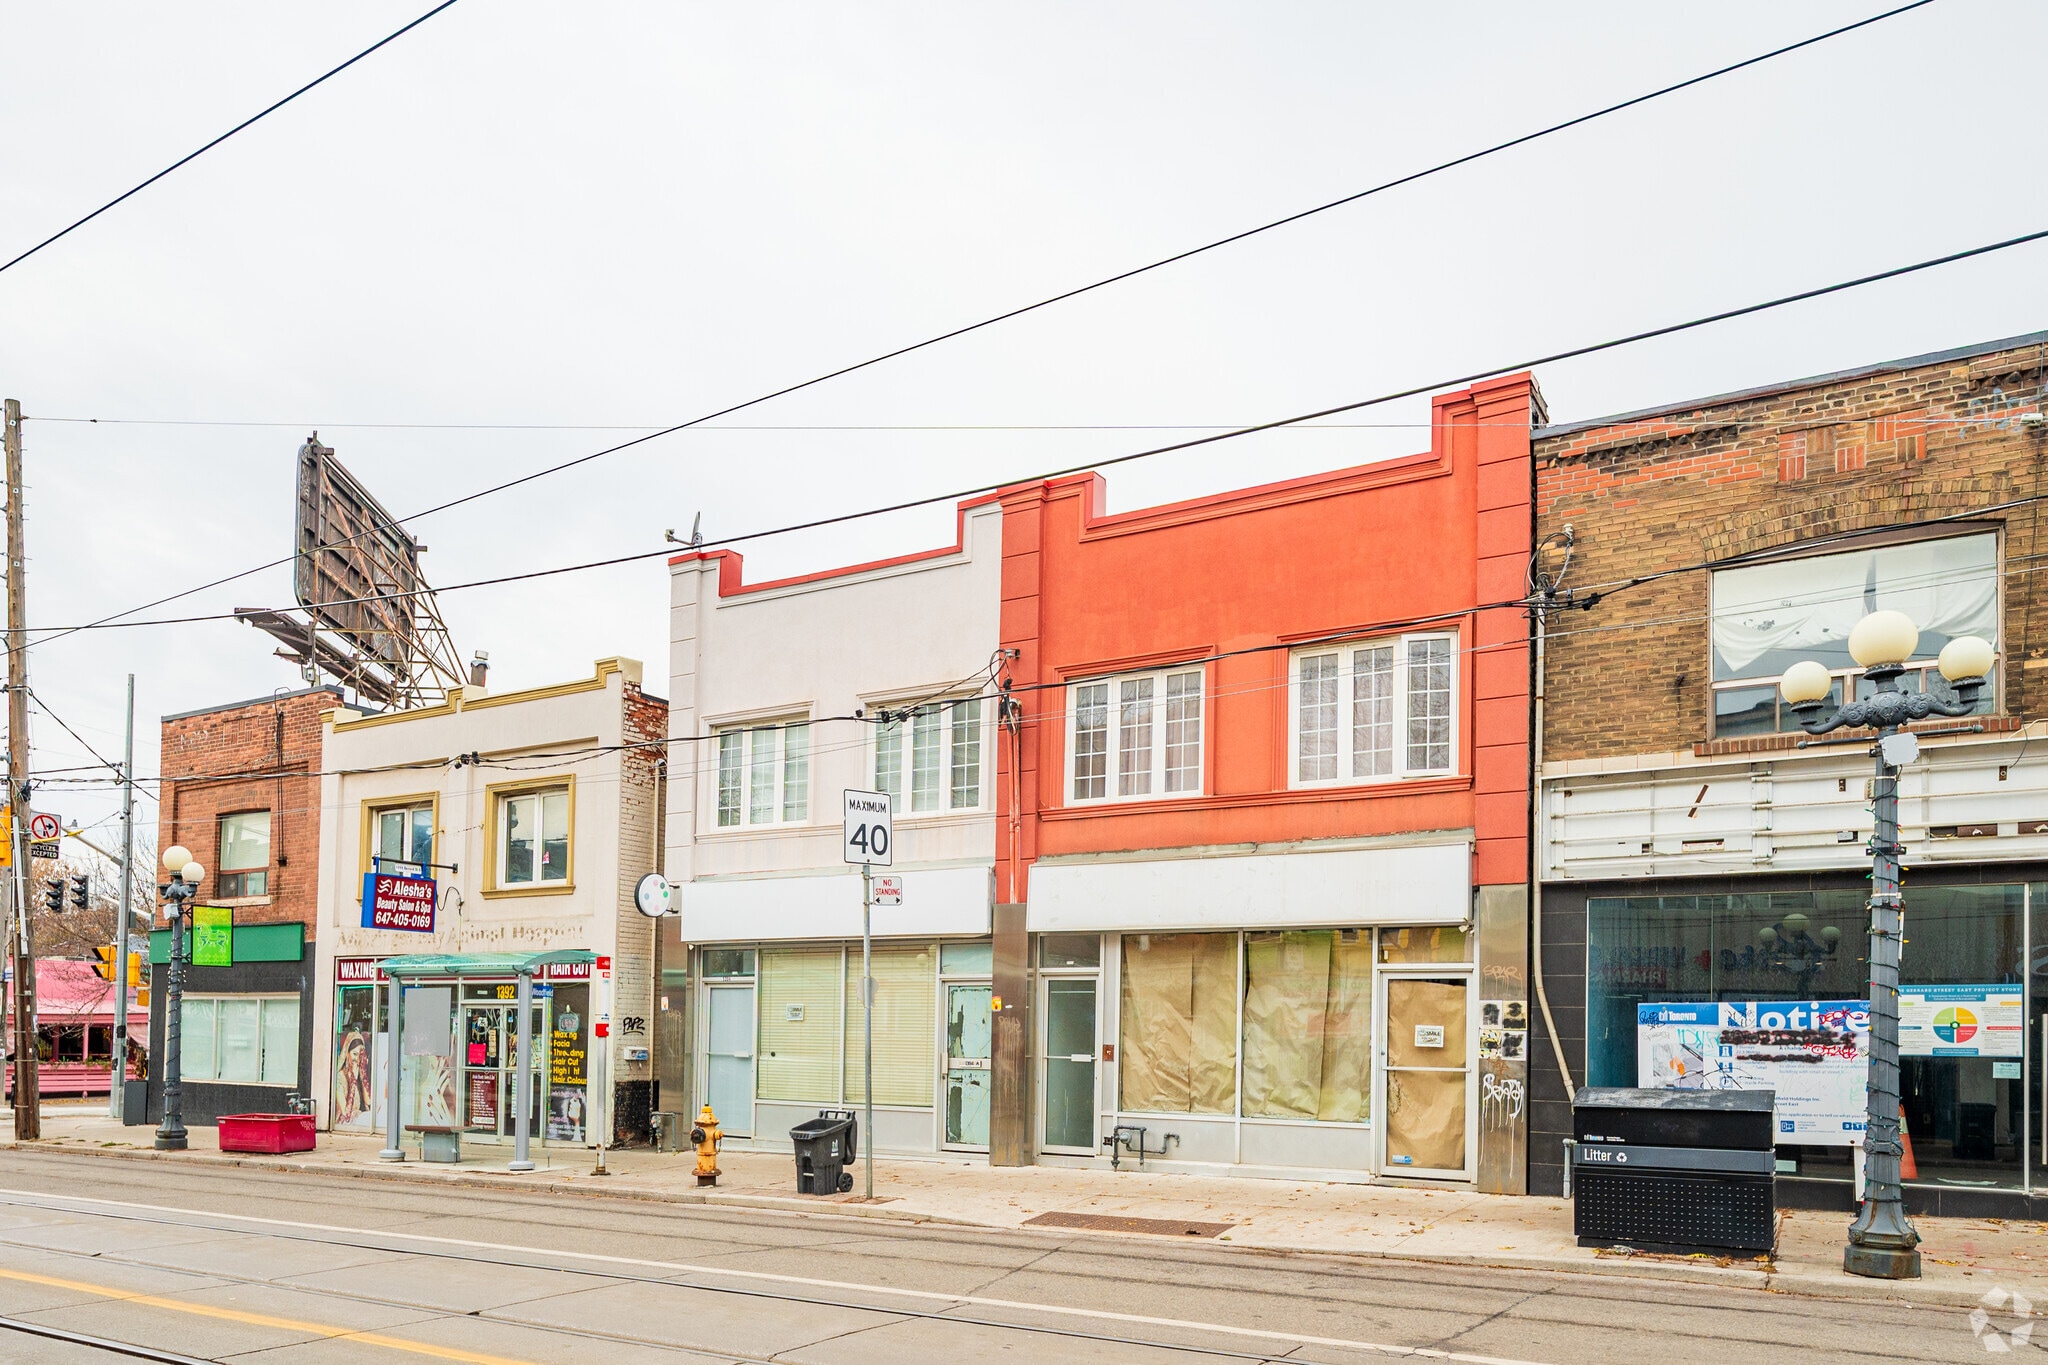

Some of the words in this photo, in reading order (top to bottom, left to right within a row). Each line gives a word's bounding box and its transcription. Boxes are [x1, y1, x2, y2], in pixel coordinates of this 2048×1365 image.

[849, 799, 887, 814] MAXIMUM
[849, 823, 889, 856] 40
[393, 880, 433, 899] Alesha's
[882, 879, 893, 887] NO
[875, 887, 901, 897] STANDING
[376, 897, 398, 913] Beauty
[398, 898, 415, 912] Salon
[415, 901, 421, 913] &
[420, 901, 432, 915] Spa
[375, 911, 432, 928] 647-405-0169
[340, 961, 376, 979] WAXING
[496, 984, 515, 999] 1392
[553, 1030, 578, 1041] Waxng
[567, 1057, 579, 1066] Cut
[552, 1075, 566, 1084] Hair
[566, 1076, 587, 1085] Colour
[1583, 1148, 1612, 1162] Litter
